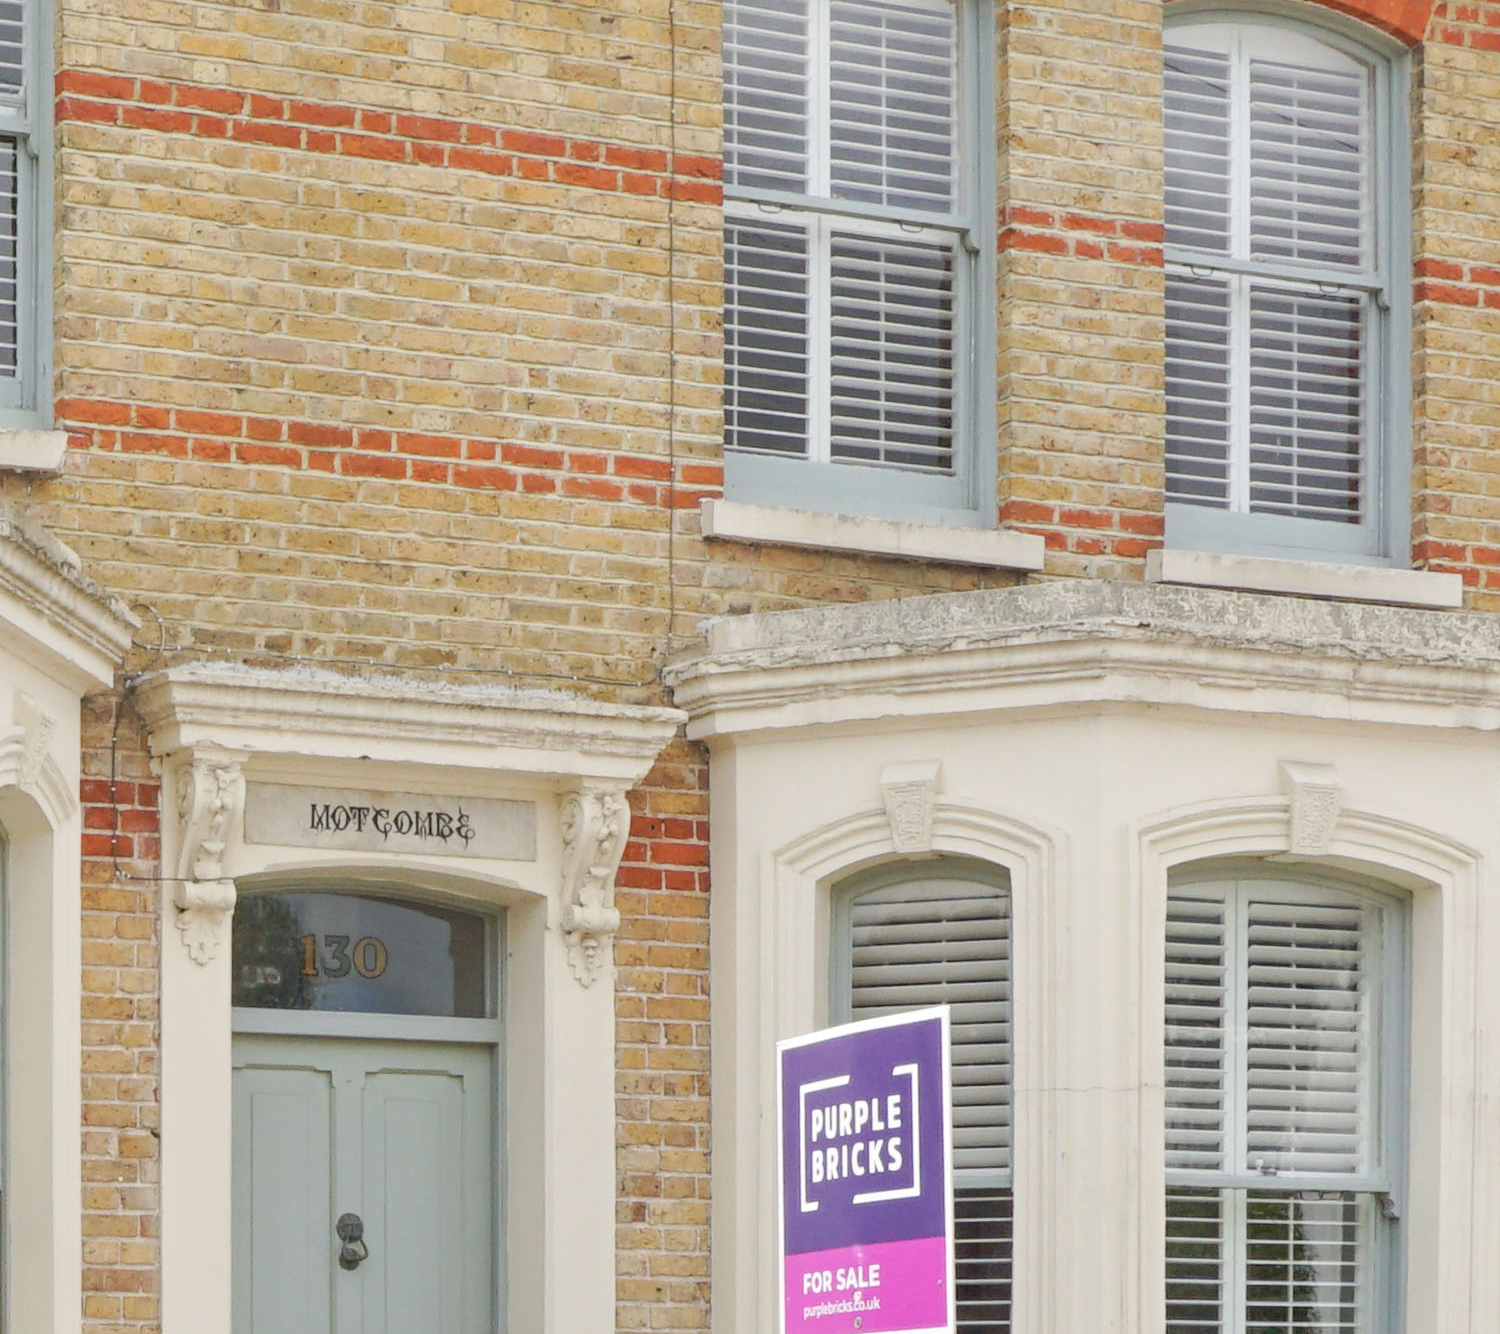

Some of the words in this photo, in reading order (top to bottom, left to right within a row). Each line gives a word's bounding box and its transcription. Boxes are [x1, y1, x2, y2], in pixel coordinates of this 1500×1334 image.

[310, 803, 476, 849] MOTCOMBE
[300, 933, 389, 979] 130
[811, 1094, 902, 1142] PURPLE
[811, 1137, 903, 1183] BRICKS
[803, 1270, 833, 1295] FOR
[836, 1264, 881, 1291] SALE
[803, 1296, 881, 1321] purplebricks.co.uk
